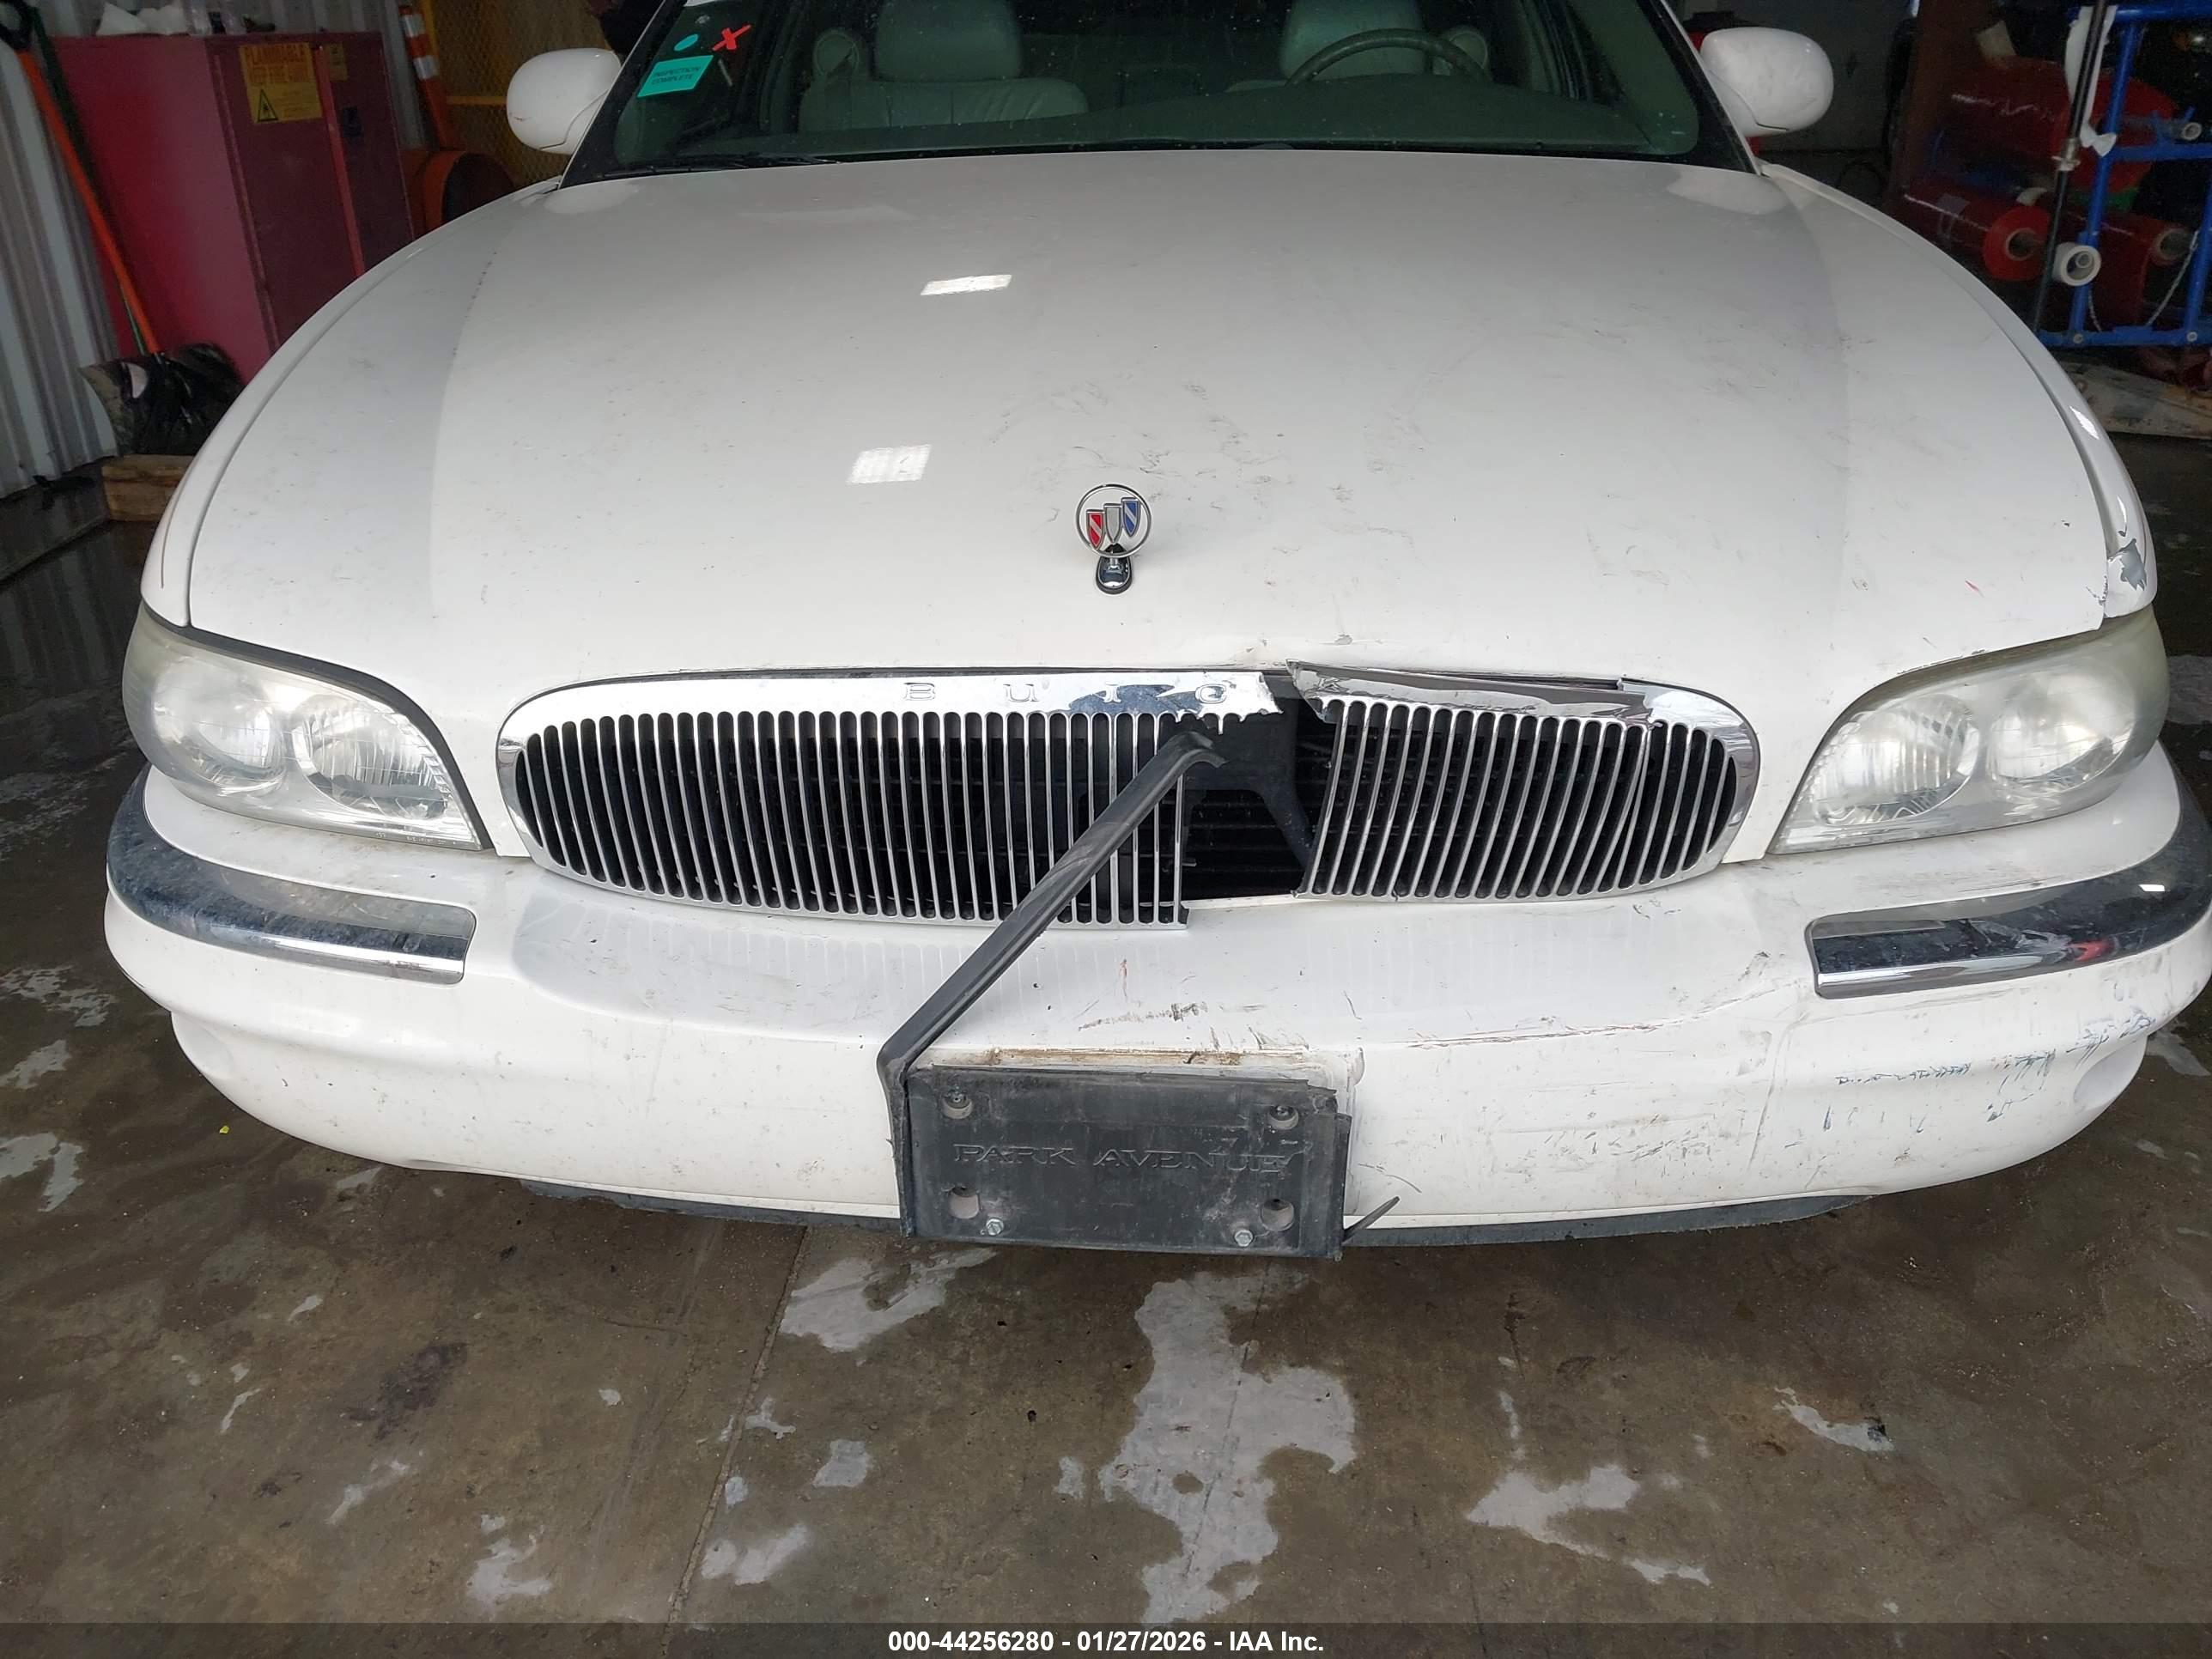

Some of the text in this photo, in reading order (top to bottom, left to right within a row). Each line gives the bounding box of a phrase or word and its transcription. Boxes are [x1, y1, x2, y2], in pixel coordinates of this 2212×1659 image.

[652, 74, 693, 84] COMPLETE
[653, 66, 701, 77] INSPECTION
[953, 1143, 1077, 1166] PARK
[1092, 1148, 1286, 1174] AVENUE
